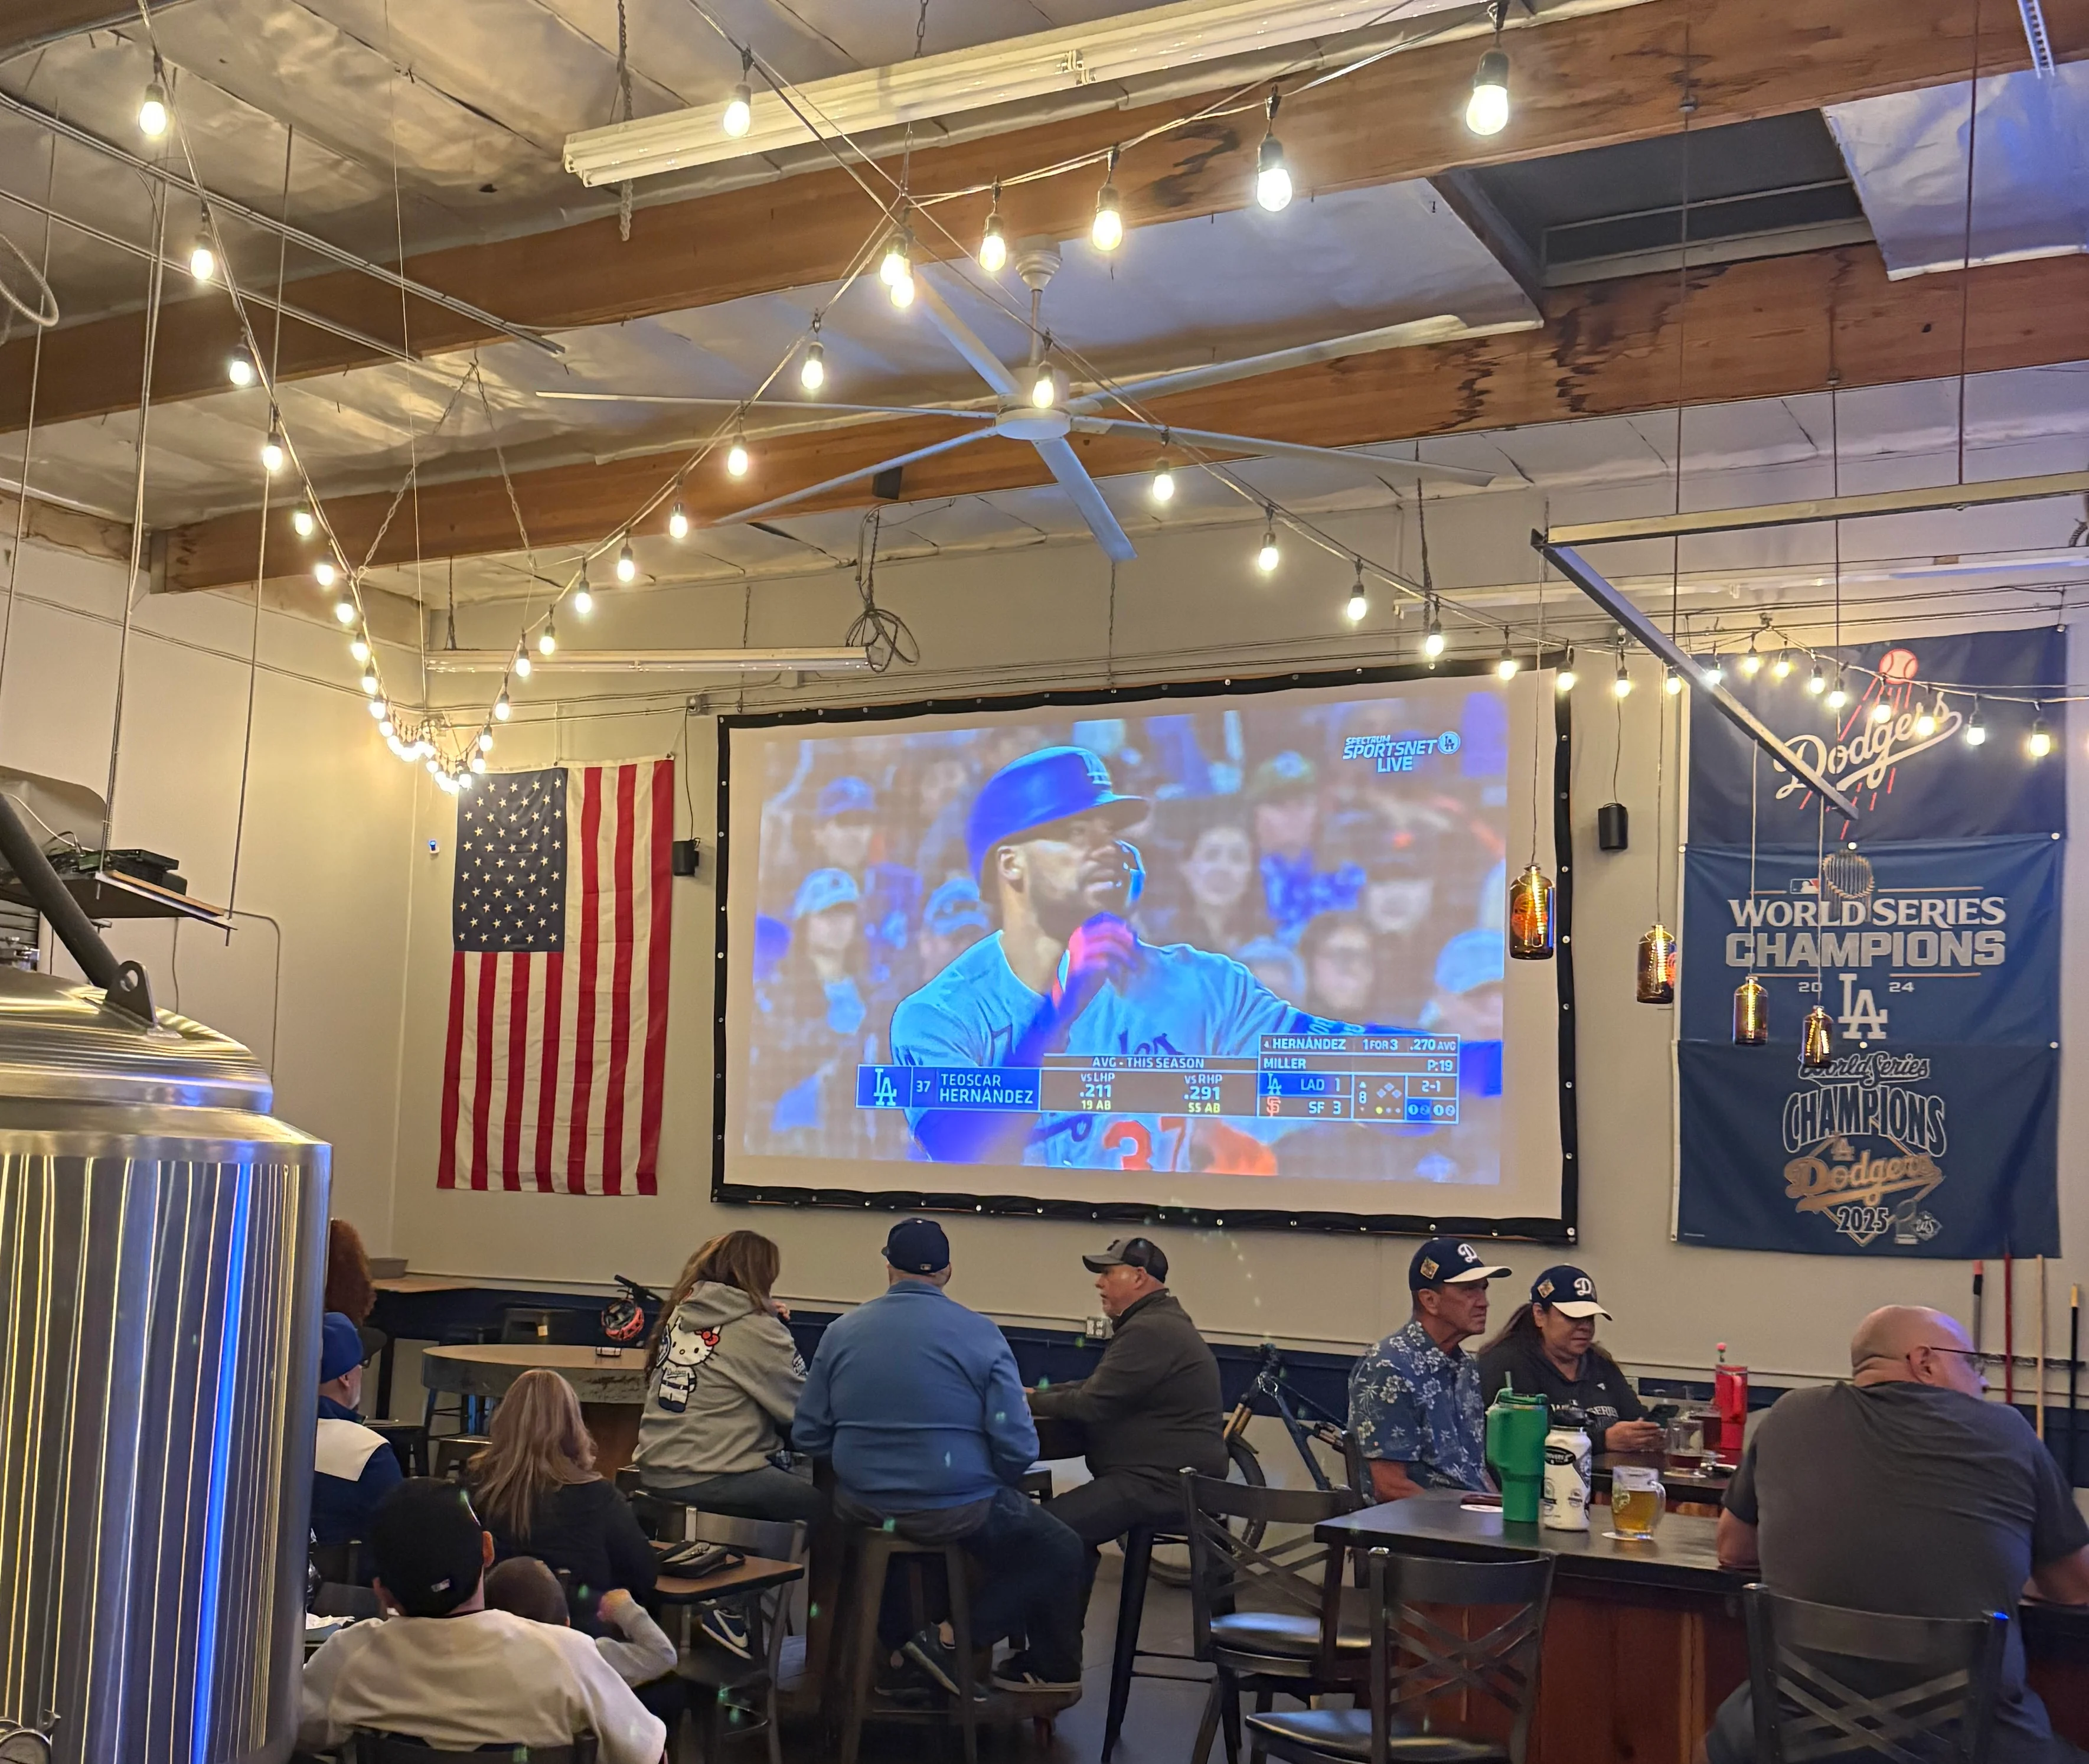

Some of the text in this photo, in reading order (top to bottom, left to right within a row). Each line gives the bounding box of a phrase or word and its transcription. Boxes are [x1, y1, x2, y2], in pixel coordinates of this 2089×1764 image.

[1346, 735, 1391, 746] SPECTRUM
[1343, 739, 1438, 759] SPORTSNET
[1378, 756, 1413, 772] LIVE
[1727, 896, 2006, 928] WORLD SERIES
[1725, 930, 2006, 967] CHAMPIONS
[1889, 982, 1915, 992] 24
[1838, 973, 1888, 1039] LA
[1272, 1036, 1346, 1051] HERNÁNDEZ
[1410, 1039, 1457, 1051] .270 AVG
[1092, 1057, 1205, 1068] AVG THIS SEASON
[1264, 1058, 1307, 1070] MILLER
[1427, 1060, 1454, 1071] P:19
[1094, 1072, 1115, 1082] LHP
[1860, 1051, 1930, 1090] Series
[941, 1073, 1001, 1087] TEOSCAR
[1199, 1074, 1223, 1084] RHP
[1267, 1072, 1340, 1095] LA LAD 1
[873, 1068, 897, 1107] LA
[916, 1080, 931, 1093] 37
[1079, 1084, 1112, 1098] .211
[1183, 1086, 1220, 1100] .291
[1421, 1080, 1441, 1093] 2-1
[939, 1087, 1034, 1104] HERNÁNDEZ
[1359, 1091, 1366, 1104] 8
[1081, 1100, 1112, 1110] 19 AB
[1205, 1103, 1221, 1113] AB
[1308, 1101, 1325, 1114] SF
[1333, 1101, 1341, 1115] 3
[1783, 1084, 1947, 1157] CHAMPIONS
[1784, 1149, 1944, 1212] Dodgers
[1836, 1206, 1889, 1234] 2025
[1574, 1277, 1592, 1296] D
